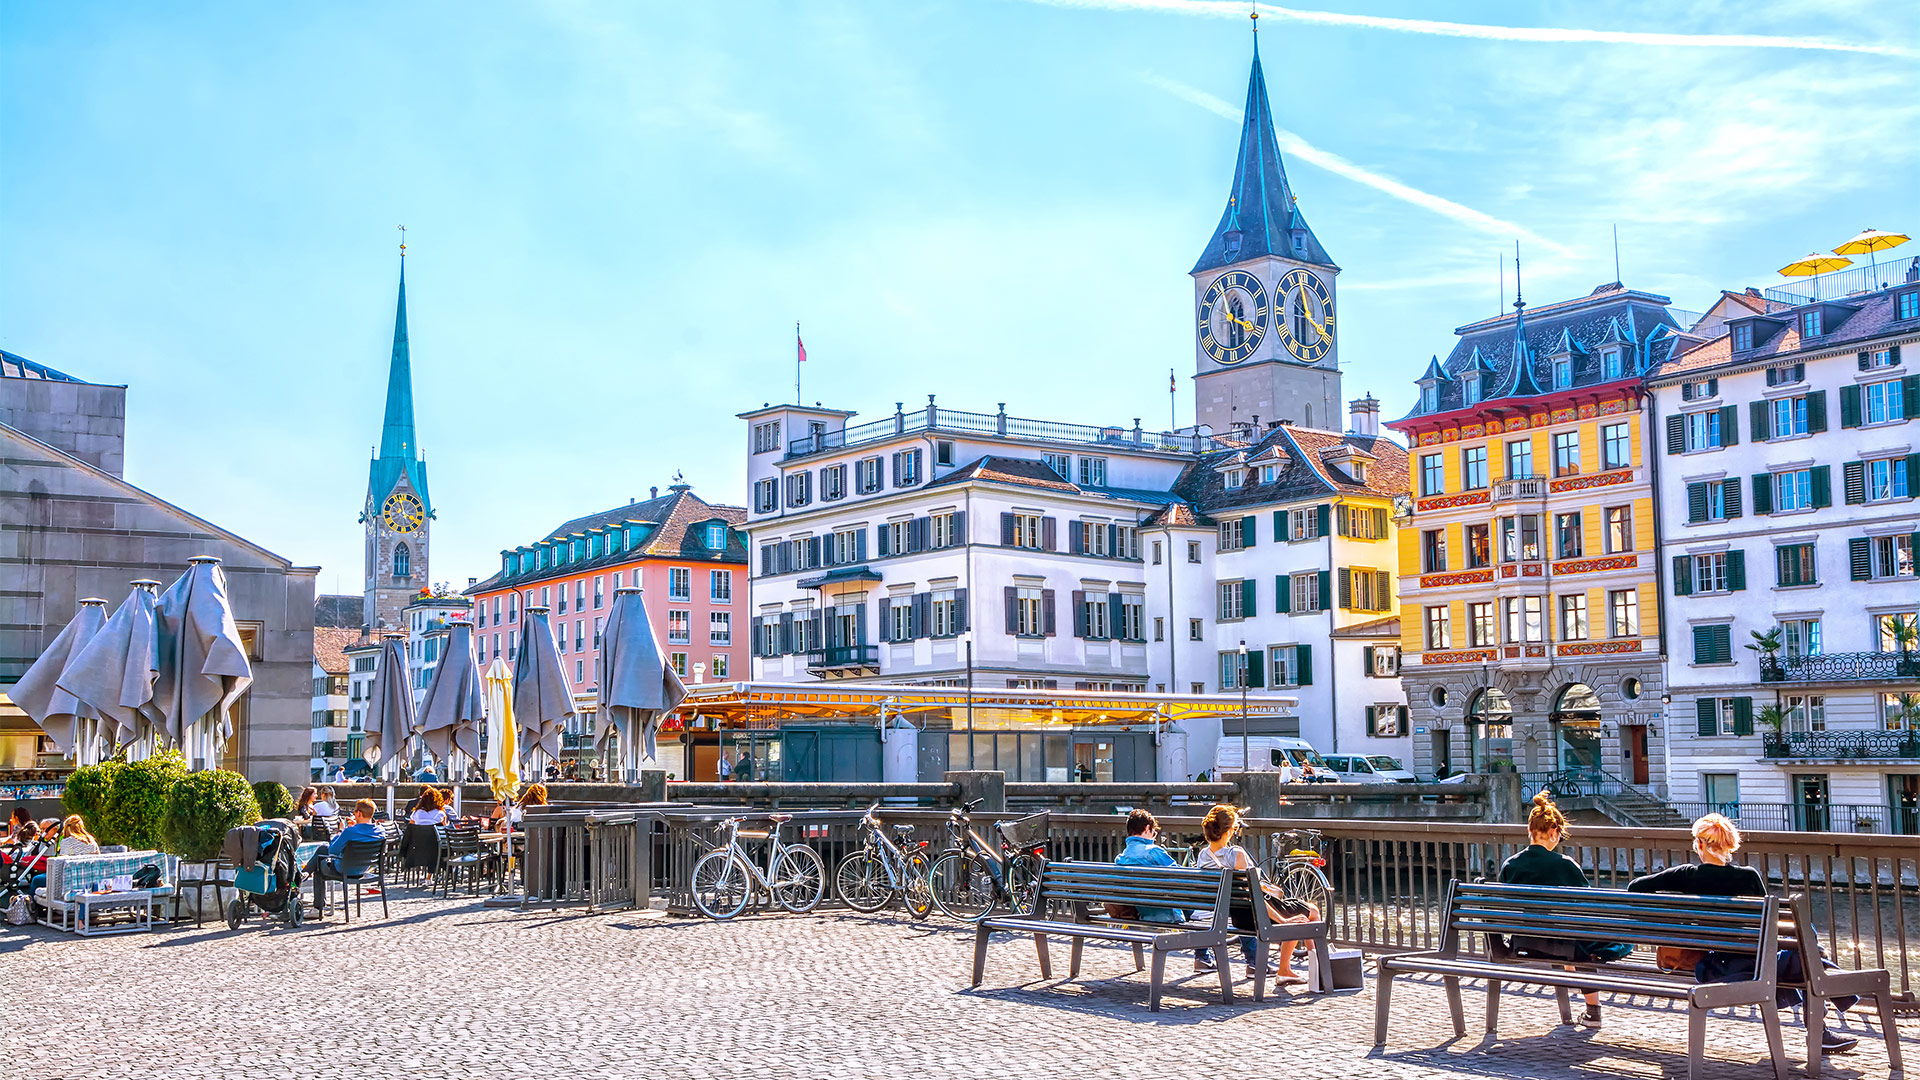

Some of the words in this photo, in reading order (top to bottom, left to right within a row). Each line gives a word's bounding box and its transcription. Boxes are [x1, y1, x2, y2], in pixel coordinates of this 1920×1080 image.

[1226, 274, 1237, 287] XII
[1244, 277, 1249, 287] I
[1287, 275, 1296, 286] XI
[1315, 281, 1319, 290] I
[1254, 288, 1263, 298] II
[1277, 286, 1287, 298] X
[1203, 300, 1212, 309] X
[1322, 297, 1330, 306] II
[1257, 305, 1267, 316] III
[1325, 316, 1334, 325] III
